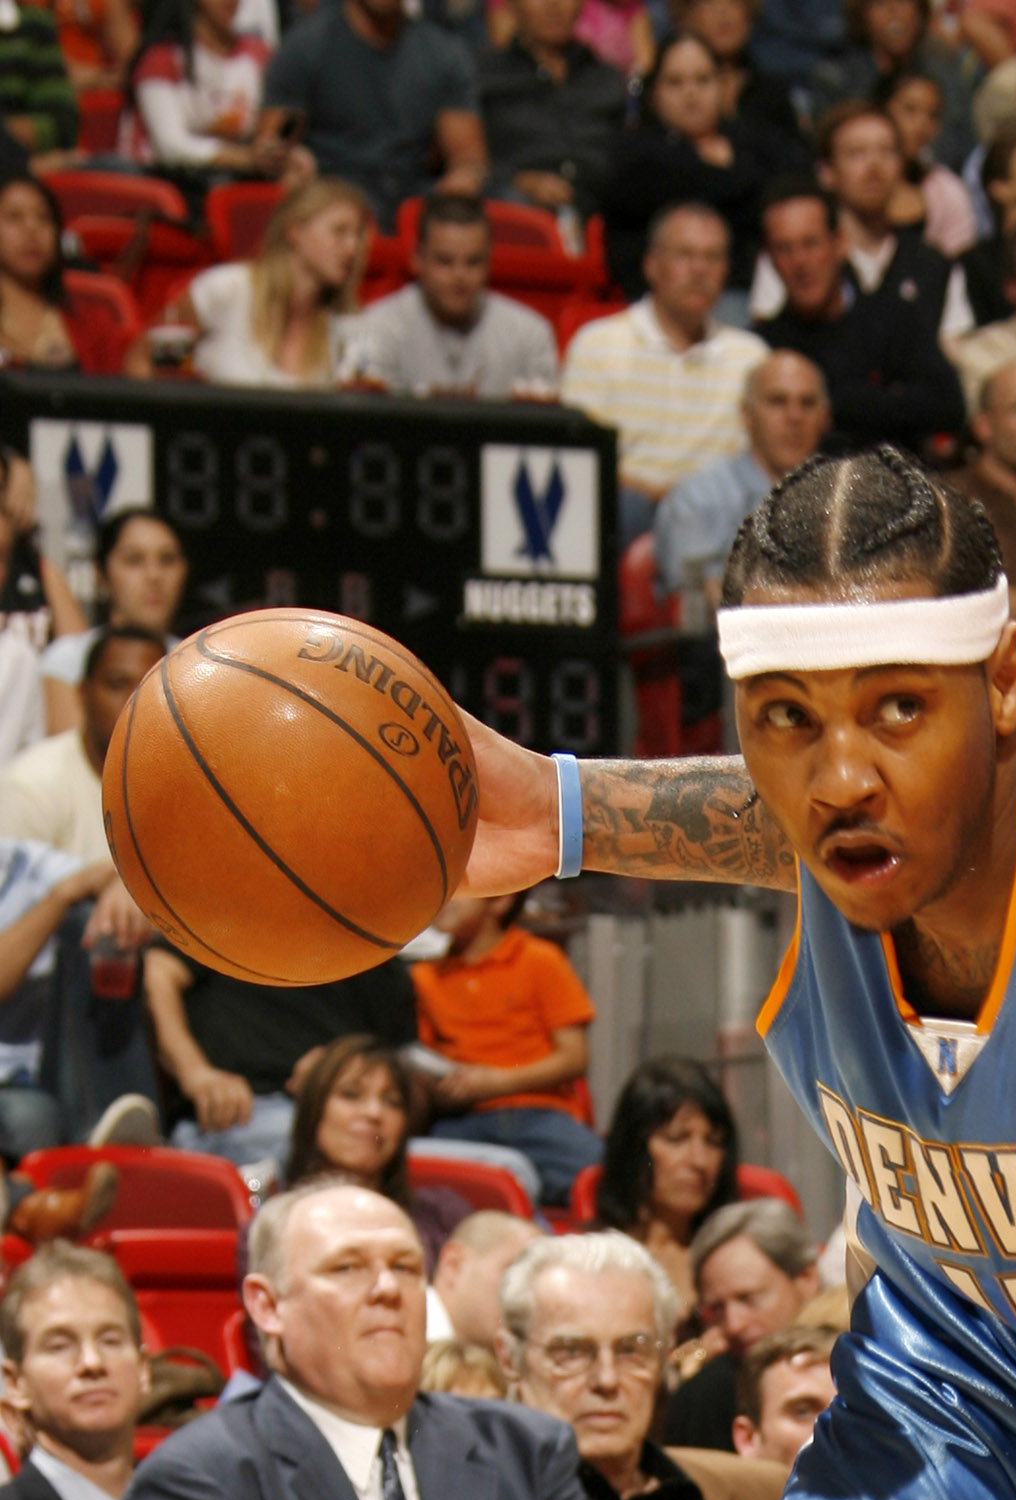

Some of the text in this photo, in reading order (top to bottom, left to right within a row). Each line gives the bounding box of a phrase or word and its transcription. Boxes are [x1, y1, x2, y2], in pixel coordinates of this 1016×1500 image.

[463, 579, 596, 627] NUGGETS
[297, 630, 480, 831] SPALDING
[936, 1036, 958, 1077] N
